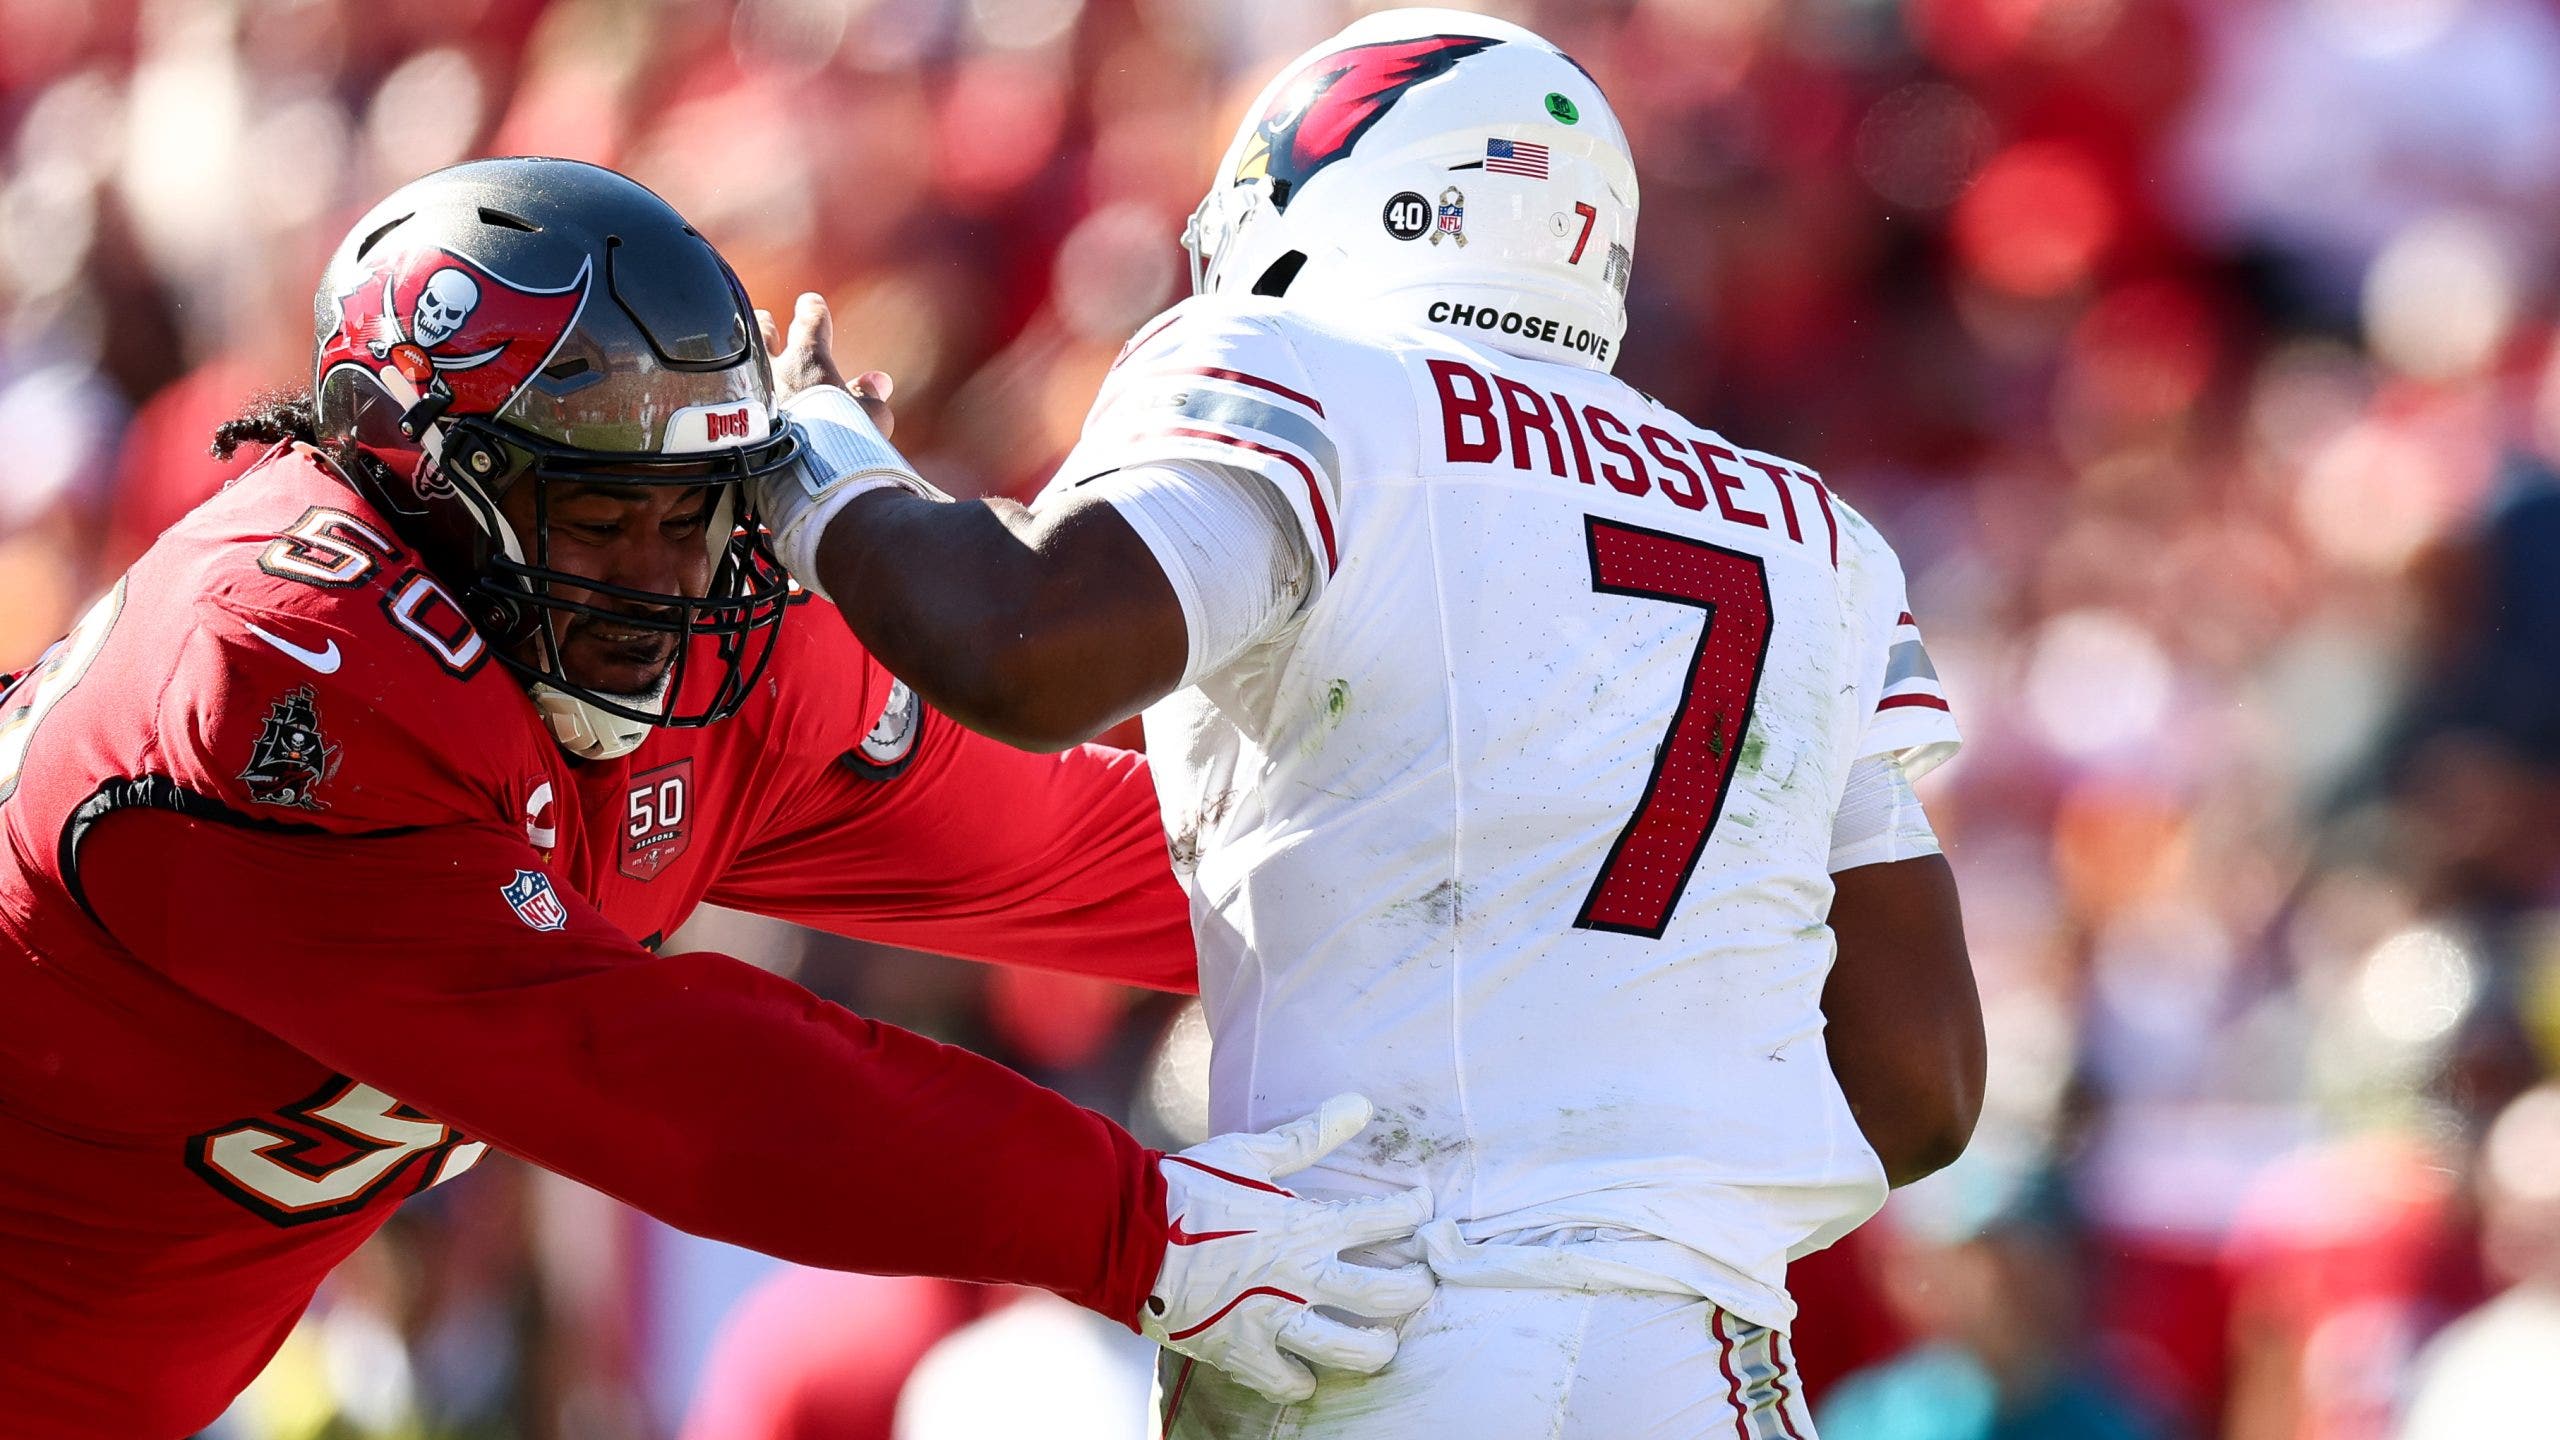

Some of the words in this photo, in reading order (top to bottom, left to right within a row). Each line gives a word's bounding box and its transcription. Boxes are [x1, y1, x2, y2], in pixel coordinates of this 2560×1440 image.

[1389, 202, 1423, 230] 40
[1440, 216, 1460, 231] NFL
[1568, 201, 1597, 265] 7
[1428, 302, 1559, 343] CHOOSE
[1563, 325, 1609, 361] LOVE
[1426, 359, 1839, 571] BRISSETT
[1572, 513, 1775, 940] 7
[629, 778, 683, 838] 50
[636, 831, 674, 850] SEASONS
[520, 892, 561, 927] NFL
